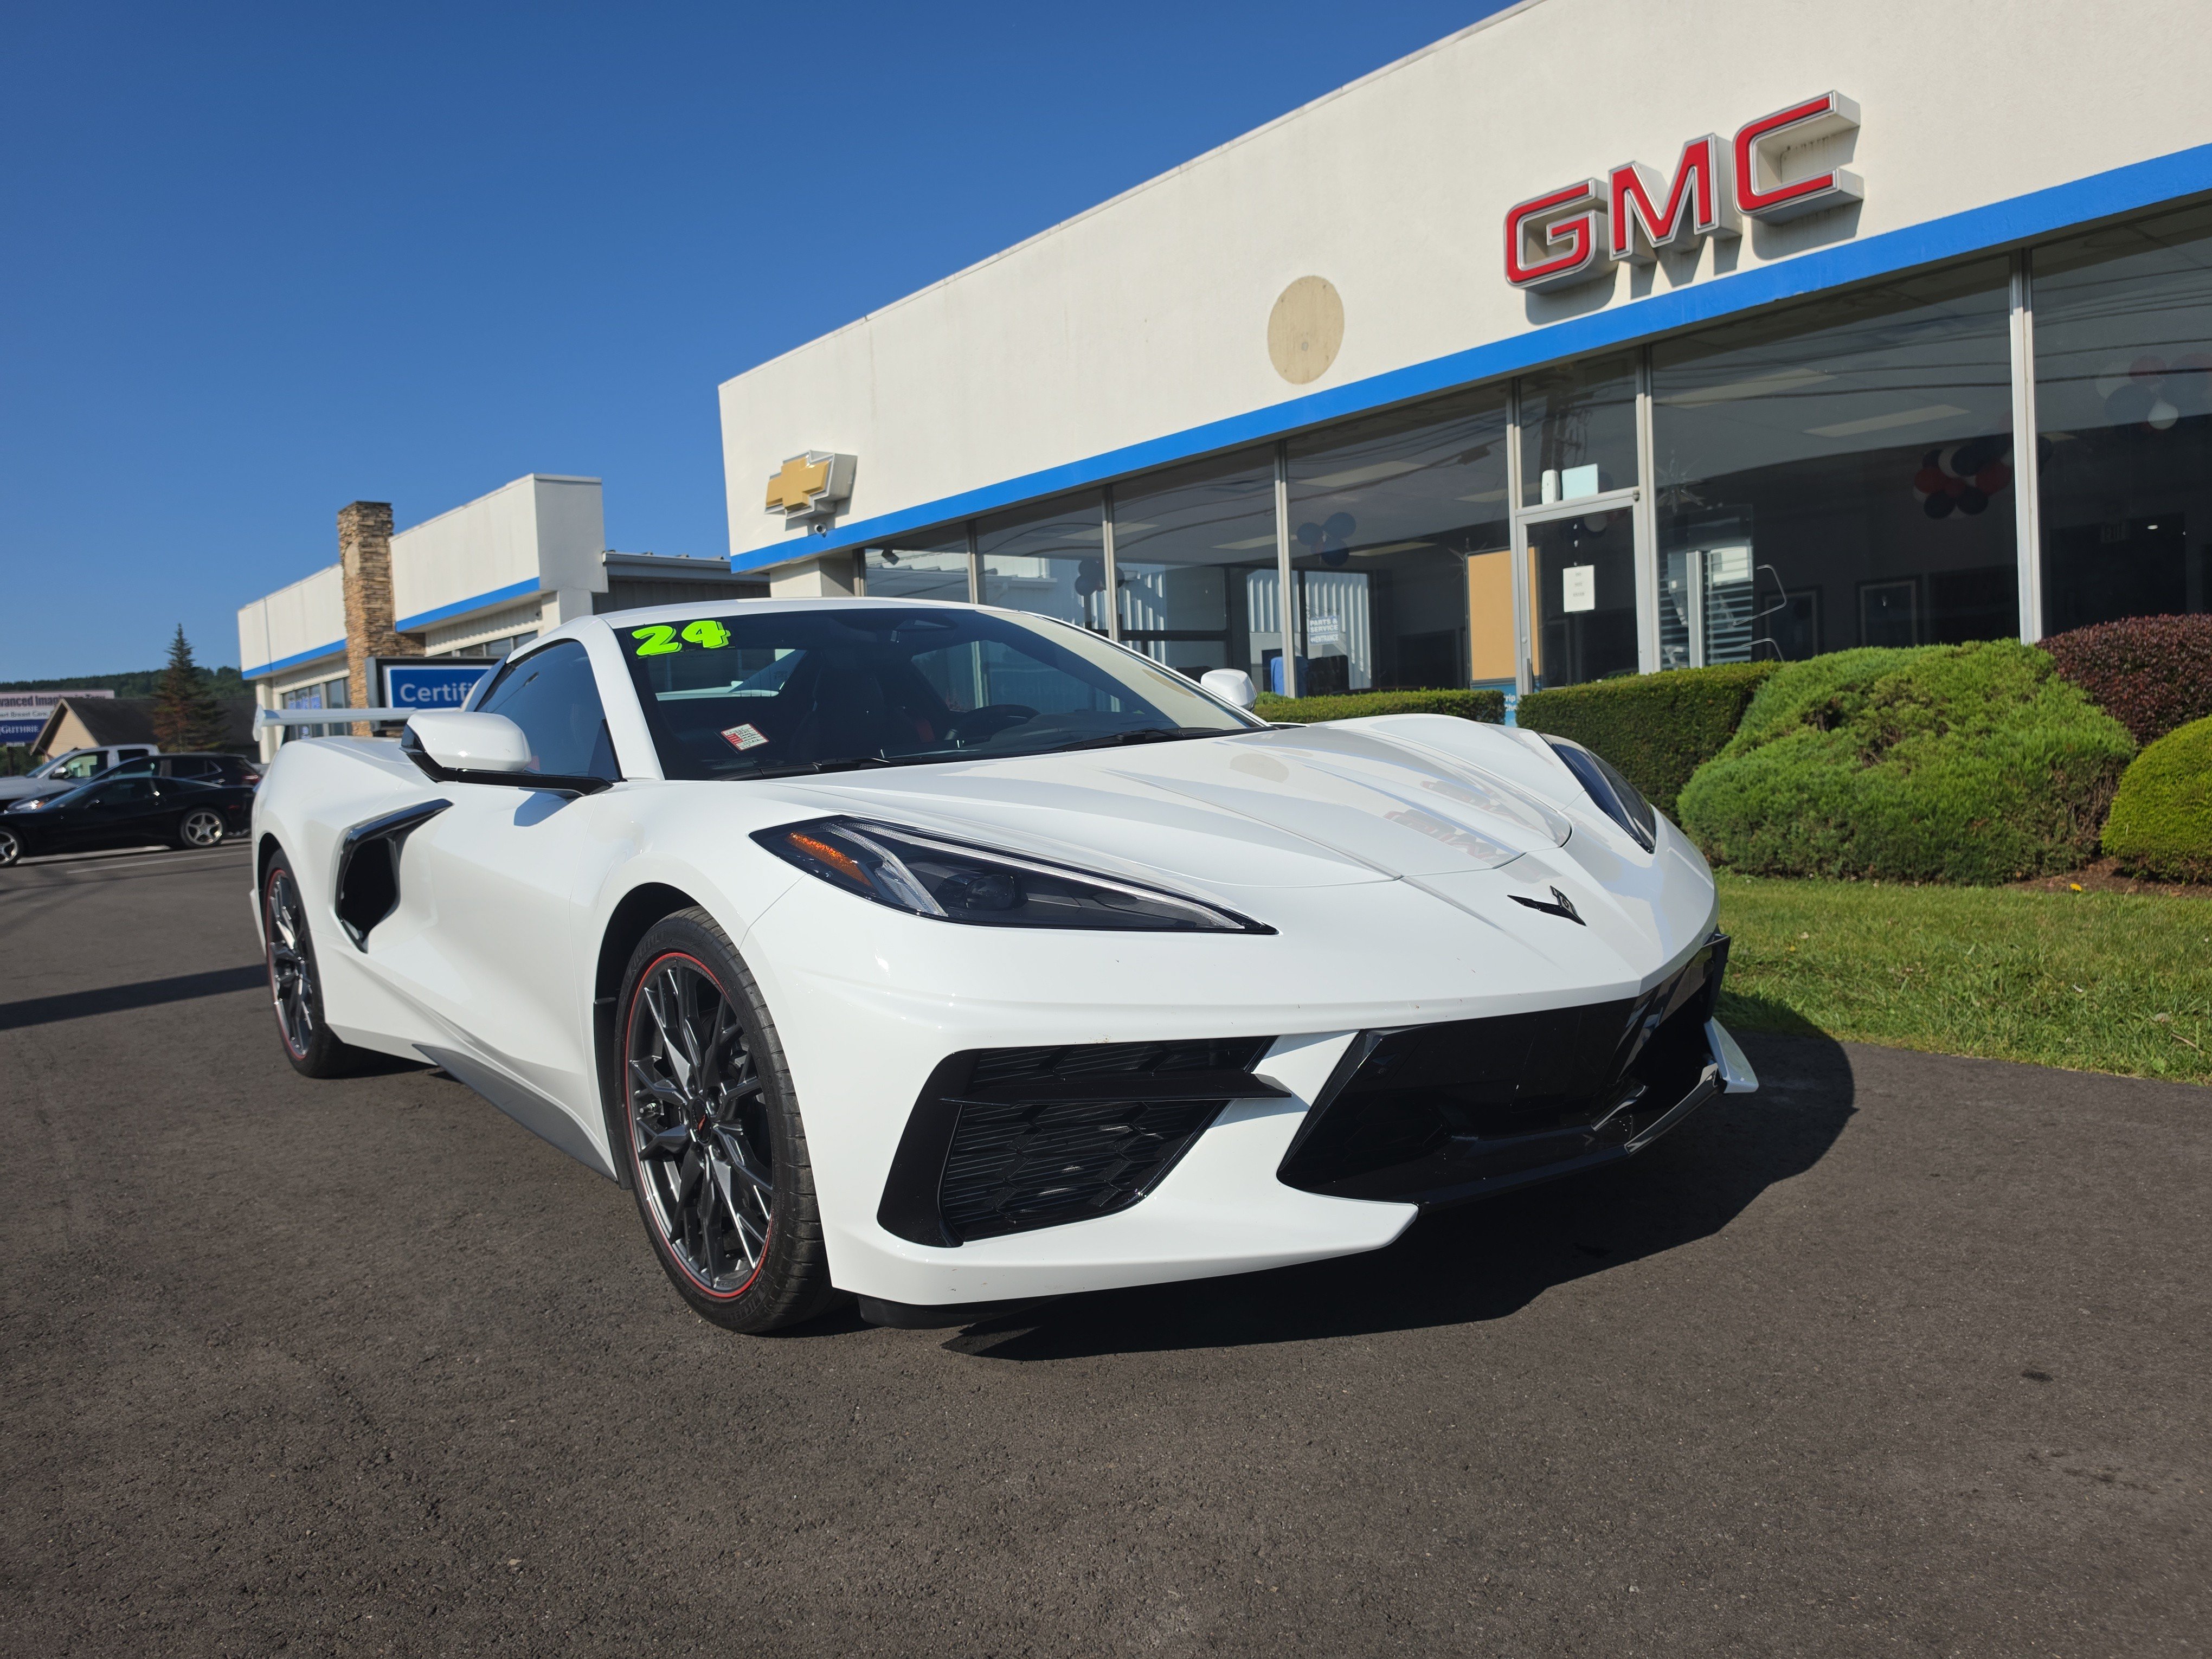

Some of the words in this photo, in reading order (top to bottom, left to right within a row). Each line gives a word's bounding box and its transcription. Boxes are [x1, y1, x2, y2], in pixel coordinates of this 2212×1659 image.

[1504, 90, 1860, 292] GMC
[1310, 619, 1332, 627] PARTS
[1310, 625, 1339, 633] SERVICE
[632, 620, 731, 657] 24
[400, 682, 472, 702] Certif
[0, 696, 34, 707] vanced
